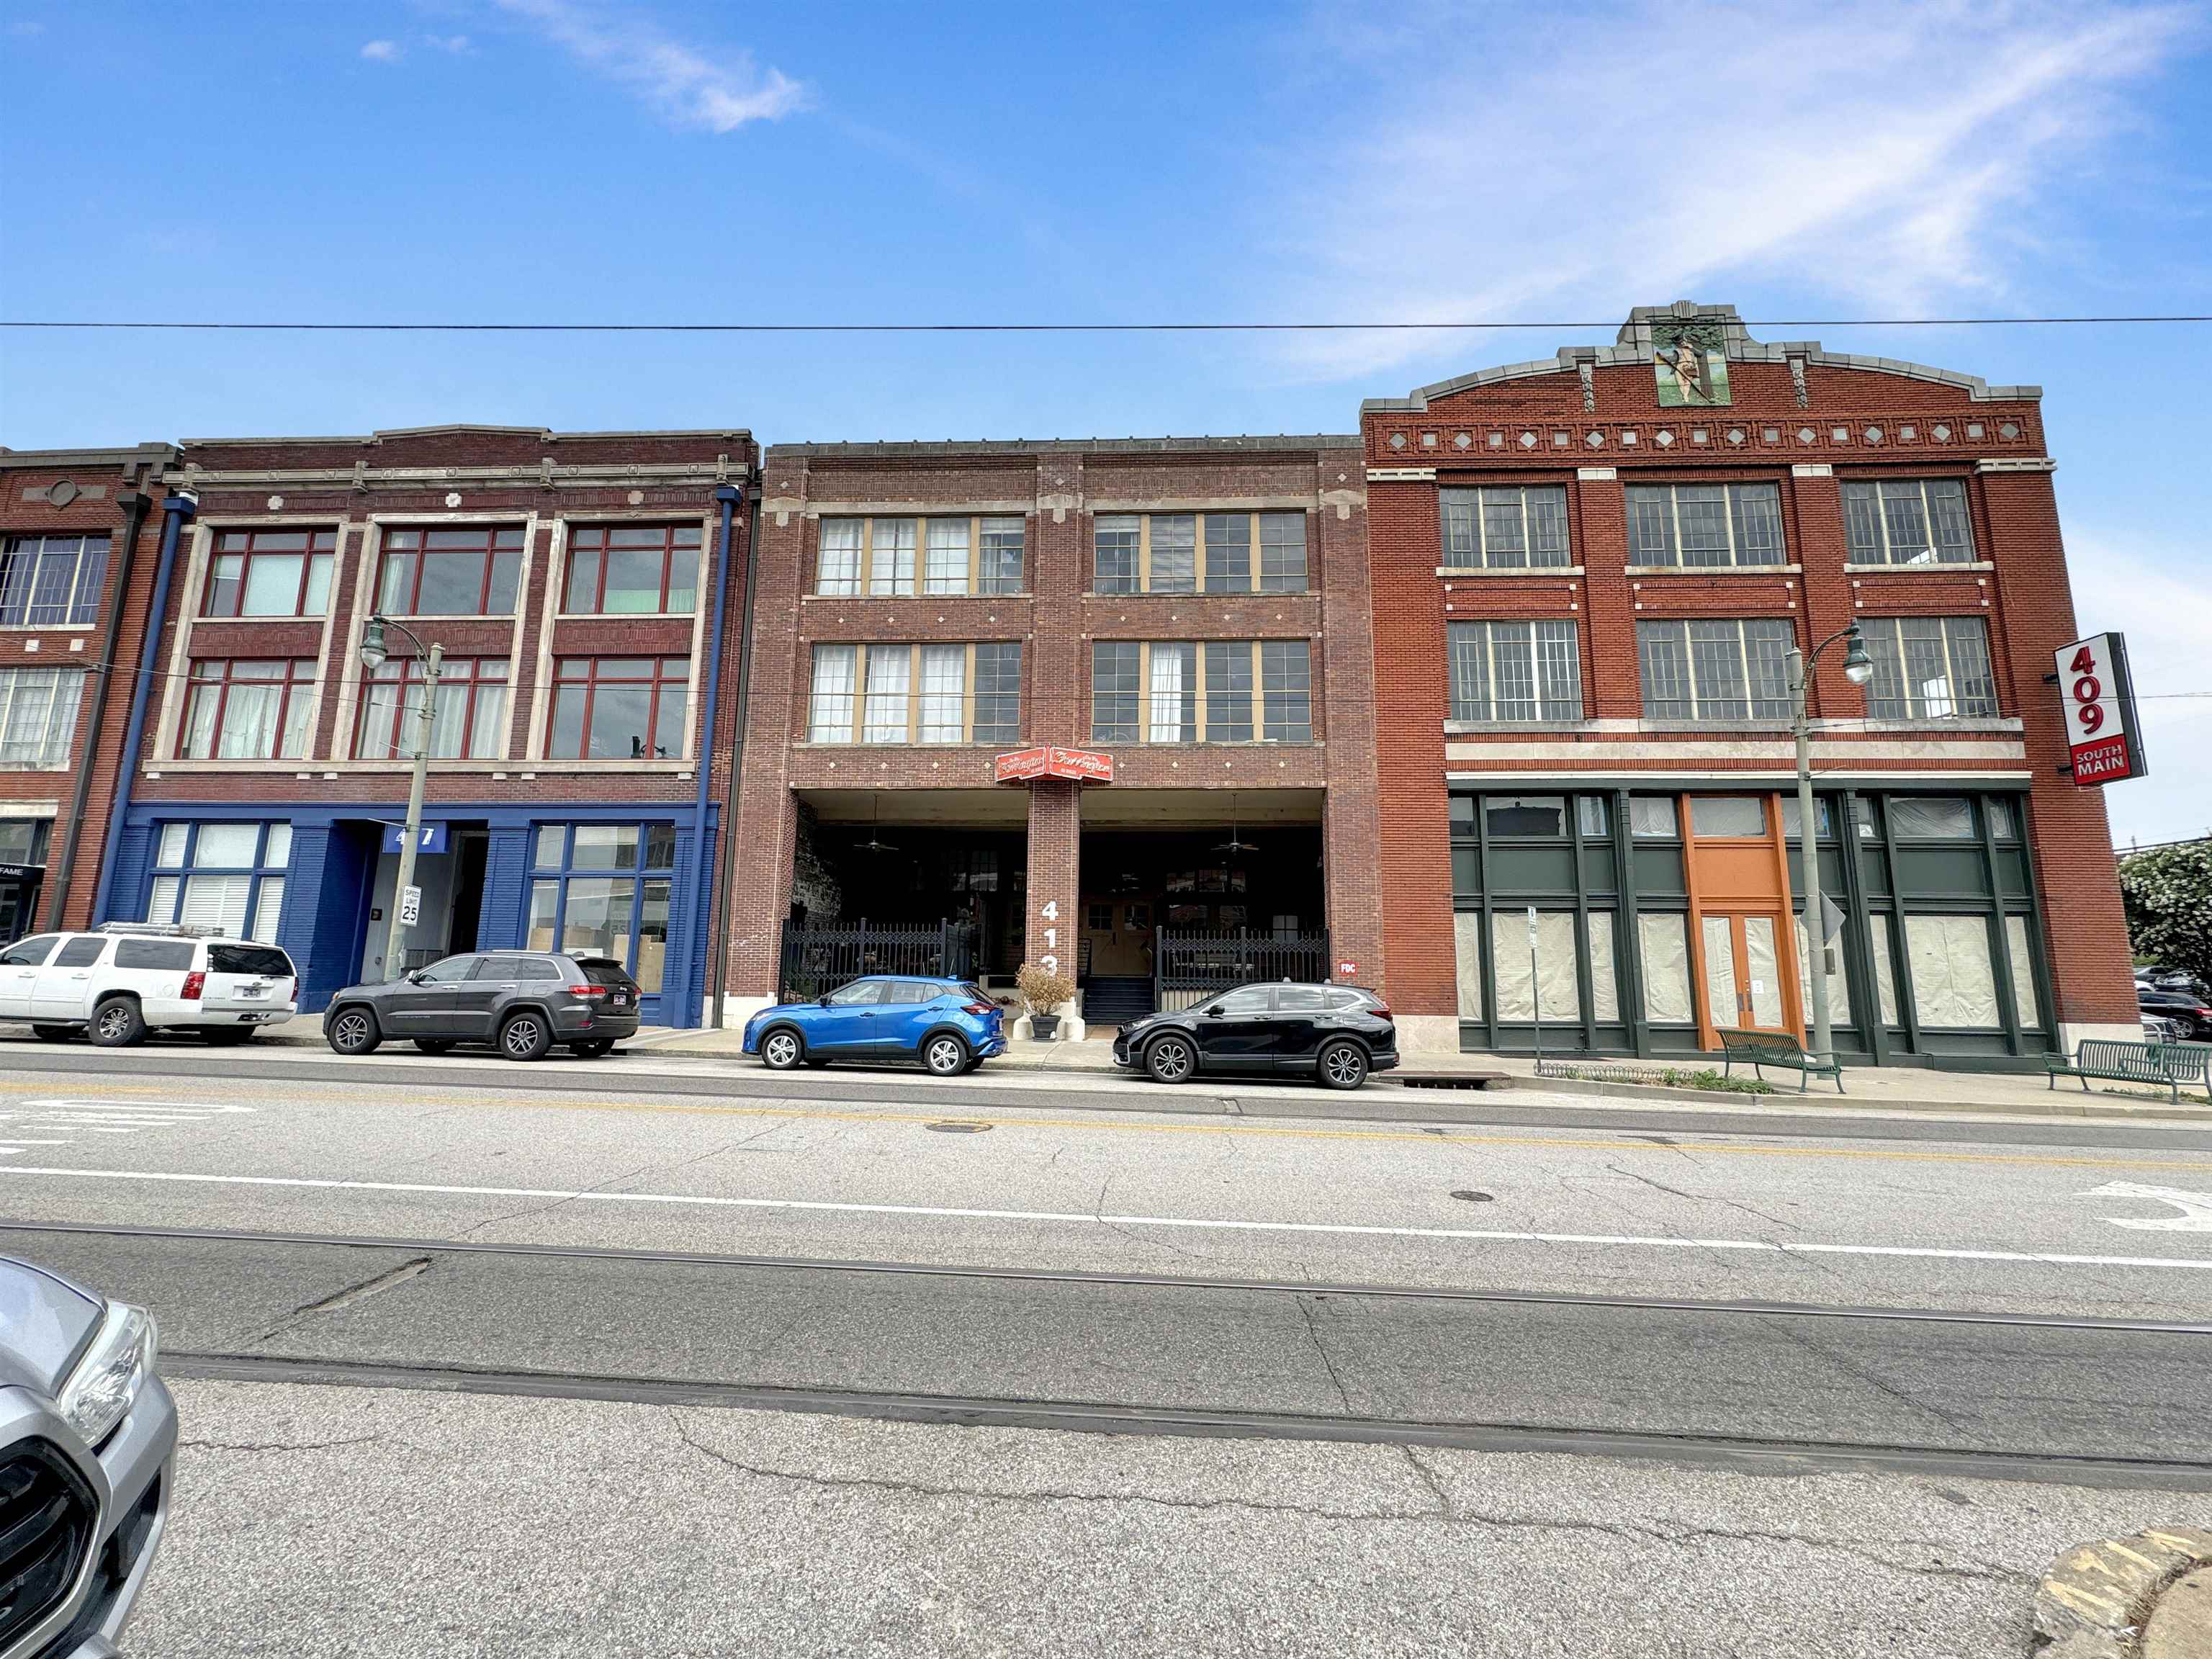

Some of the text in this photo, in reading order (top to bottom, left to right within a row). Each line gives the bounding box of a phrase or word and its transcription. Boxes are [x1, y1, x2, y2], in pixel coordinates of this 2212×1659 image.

[2070, 646, 2104, 734] 409
[2077, 744, 2123, 764] SOUTH
[2078, 756, 2124, 776] MAIN
[0, 867, 24, 876] FAME
[402, 906, 417, 921] 25
[1341, 963, 1356, 973] FDC
